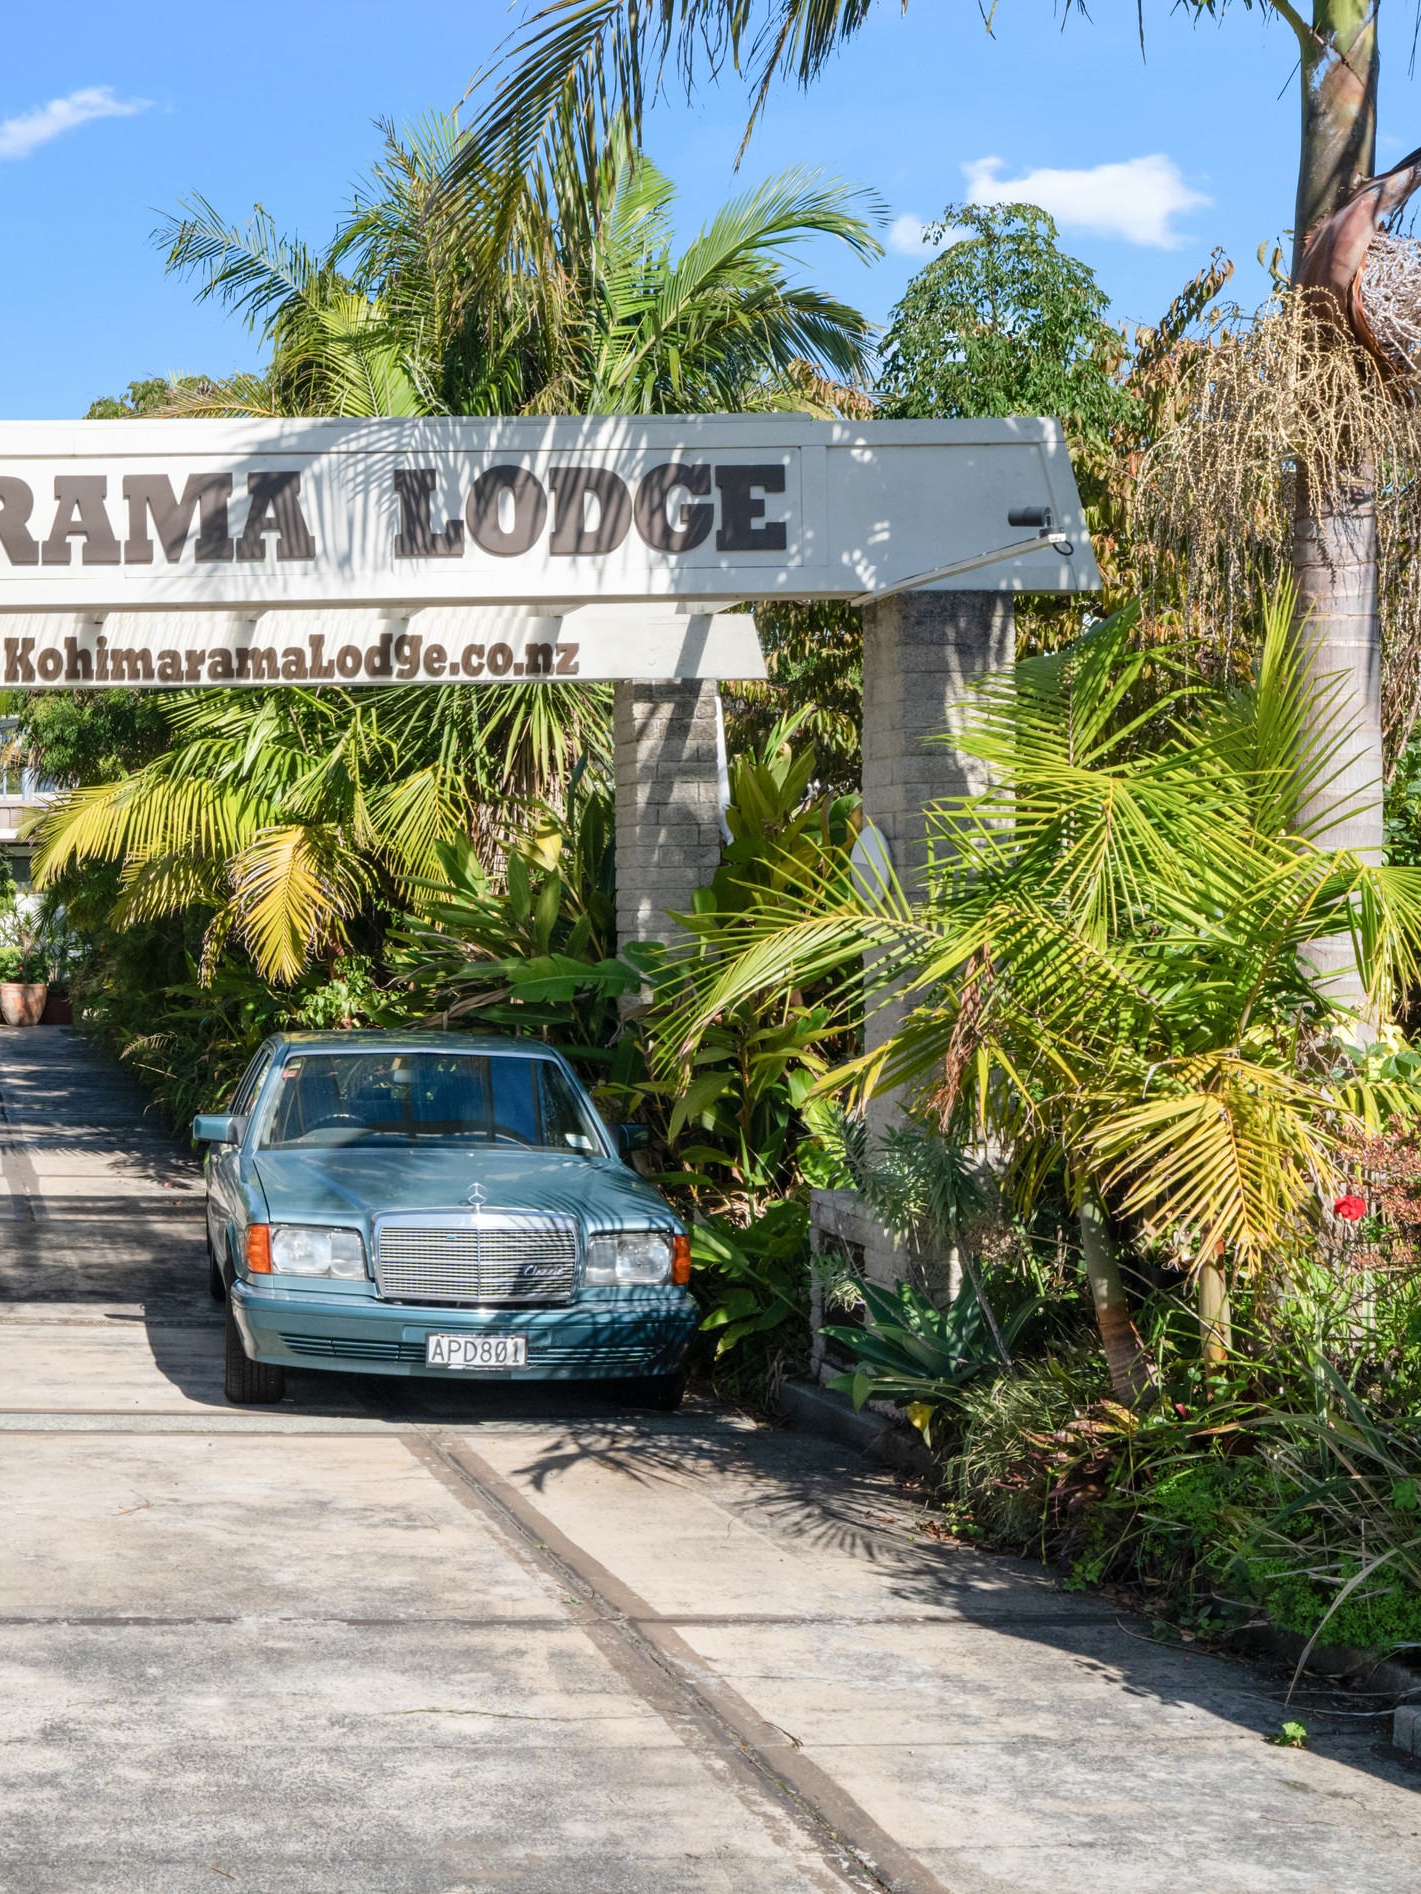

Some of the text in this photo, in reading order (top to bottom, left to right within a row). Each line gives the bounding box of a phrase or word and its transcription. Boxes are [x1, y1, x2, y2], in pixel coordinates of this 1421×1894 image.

[393, 463, 787, 558] LODGE
[4, 633, 580, 683] KohimaramaLodge.co.nz
[431, 1338, 520, 1363] APD801
